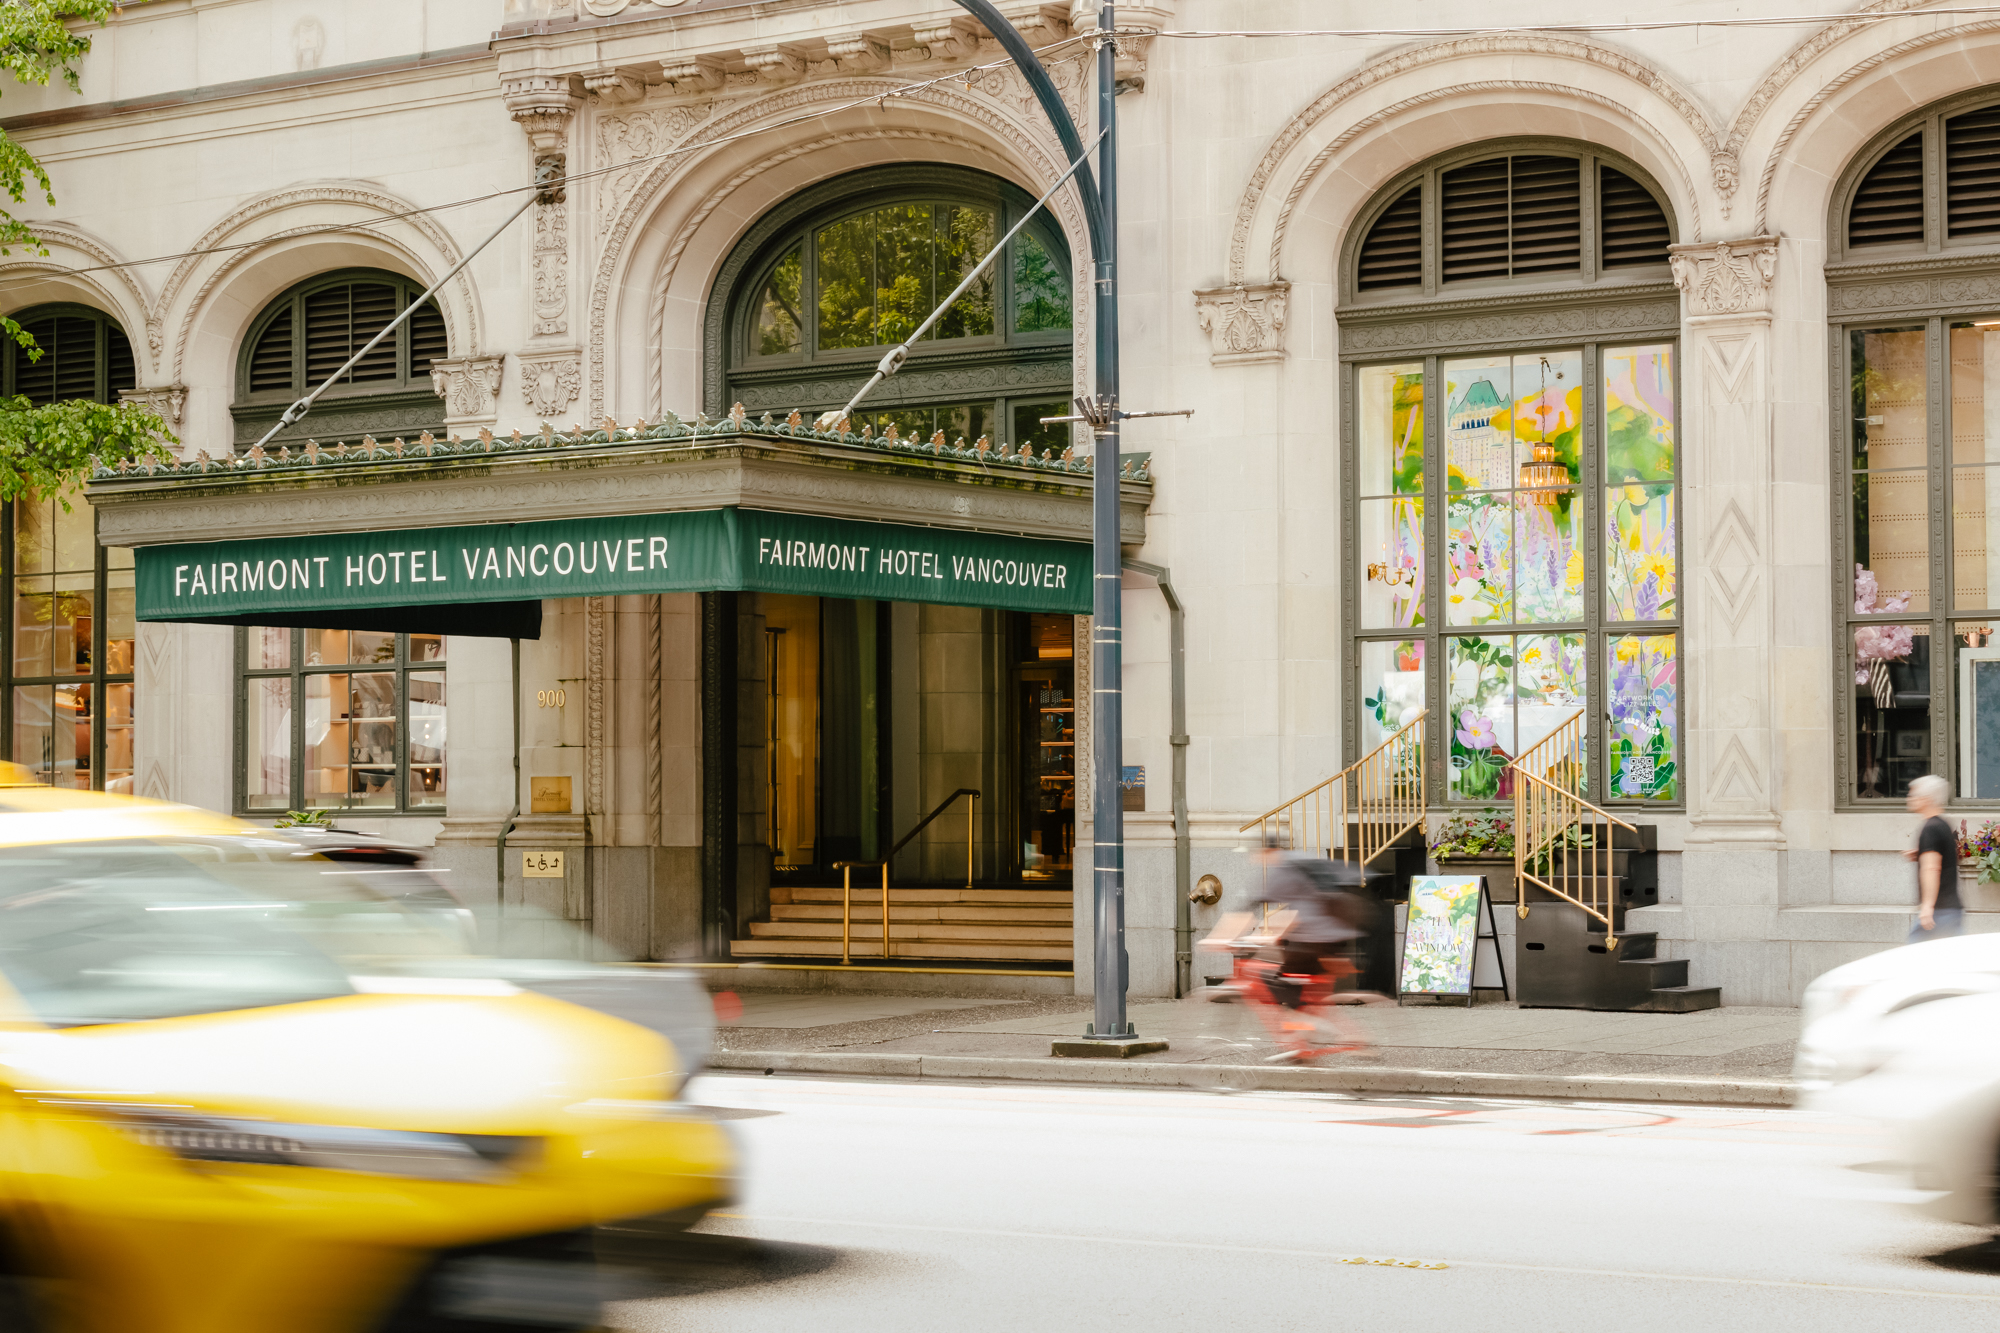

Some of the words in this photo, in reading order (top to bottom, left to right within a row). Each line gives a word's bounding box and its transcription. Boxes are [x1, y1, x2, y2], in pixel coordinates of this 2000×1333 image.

[174, 556, 330, 598] FAIRMONT
[346, 550, 447, 588] HOTEL
[462, 535, 669, 580] VANCOUVER
[759, 538, 869, 572] FAIRMONT
[879, 548, 943, 579] HOTEL
[952, 556, 1066, 588] VANCOUVER
[537, 689, 566, 708] 900
[1416, 943, 1460, 952] WINDOW
